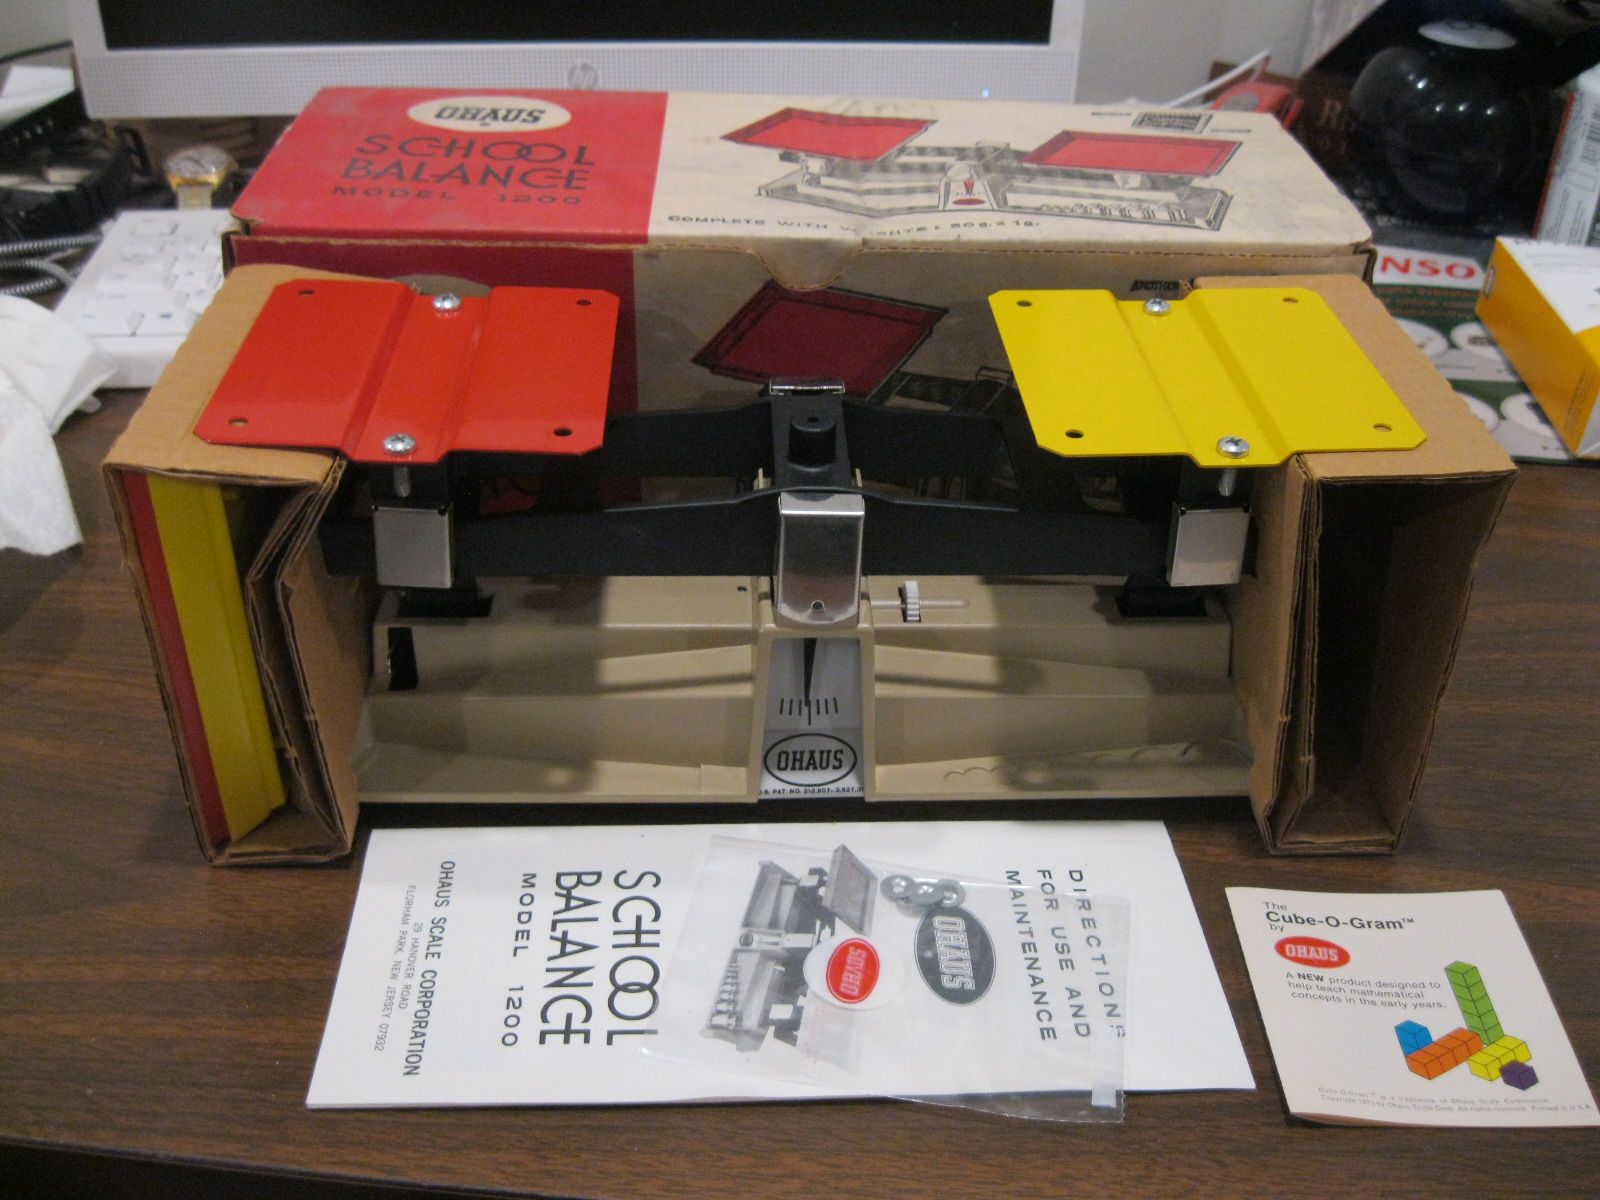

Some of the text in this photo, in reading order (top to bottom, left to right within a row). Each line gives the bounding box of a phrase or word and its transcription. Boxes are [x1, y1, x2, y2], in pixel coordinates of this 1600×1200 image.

[434, 106, 546, 124] OHAUS
[356, 134, 595, 166] SCHOOL
[340, 157, 592, 191] BALANCE
[331, 186, 582, 205] MODEL 1200
[668, 215, 766, 225] COMPLETE
[776, 749, 845, 772] OHAUS
[401, 884, 417, 926] FLORHAM
[1263, 901, 1288, 911] The
[1269, 923, 1284, 933] by
[402, 860, 456, 1077] OHAUS SCALE CORPORATION
[404, 936, 421, 980] HANOVER
[501, 873, 537, 1047] MODEL 1200
[539, 871, 602, 1045] BALANCE
[607, 869, 662, 1046] SCHOOL
[933, 915, 976, 991] OHAUS
[1005, 870, 1057, 1041] MAINTENANCE
[1037, 869, 1092, 1038] FOR USE AND
[1284, 943, 1340, 962] OHAUS
[390, 960, 402, 981] NEW
[838, 945, 867, 995] OHAUS
[1285, 971, 1441, 991] A NEW product designed to
[382, 985, 397, 1018] JERSEY
[398, 983, 412, 1010] ROAD
[1287, 980, 1425, 998] help teach mathematical
[1291, 991, 1447, 1010] concepts in the early years.
